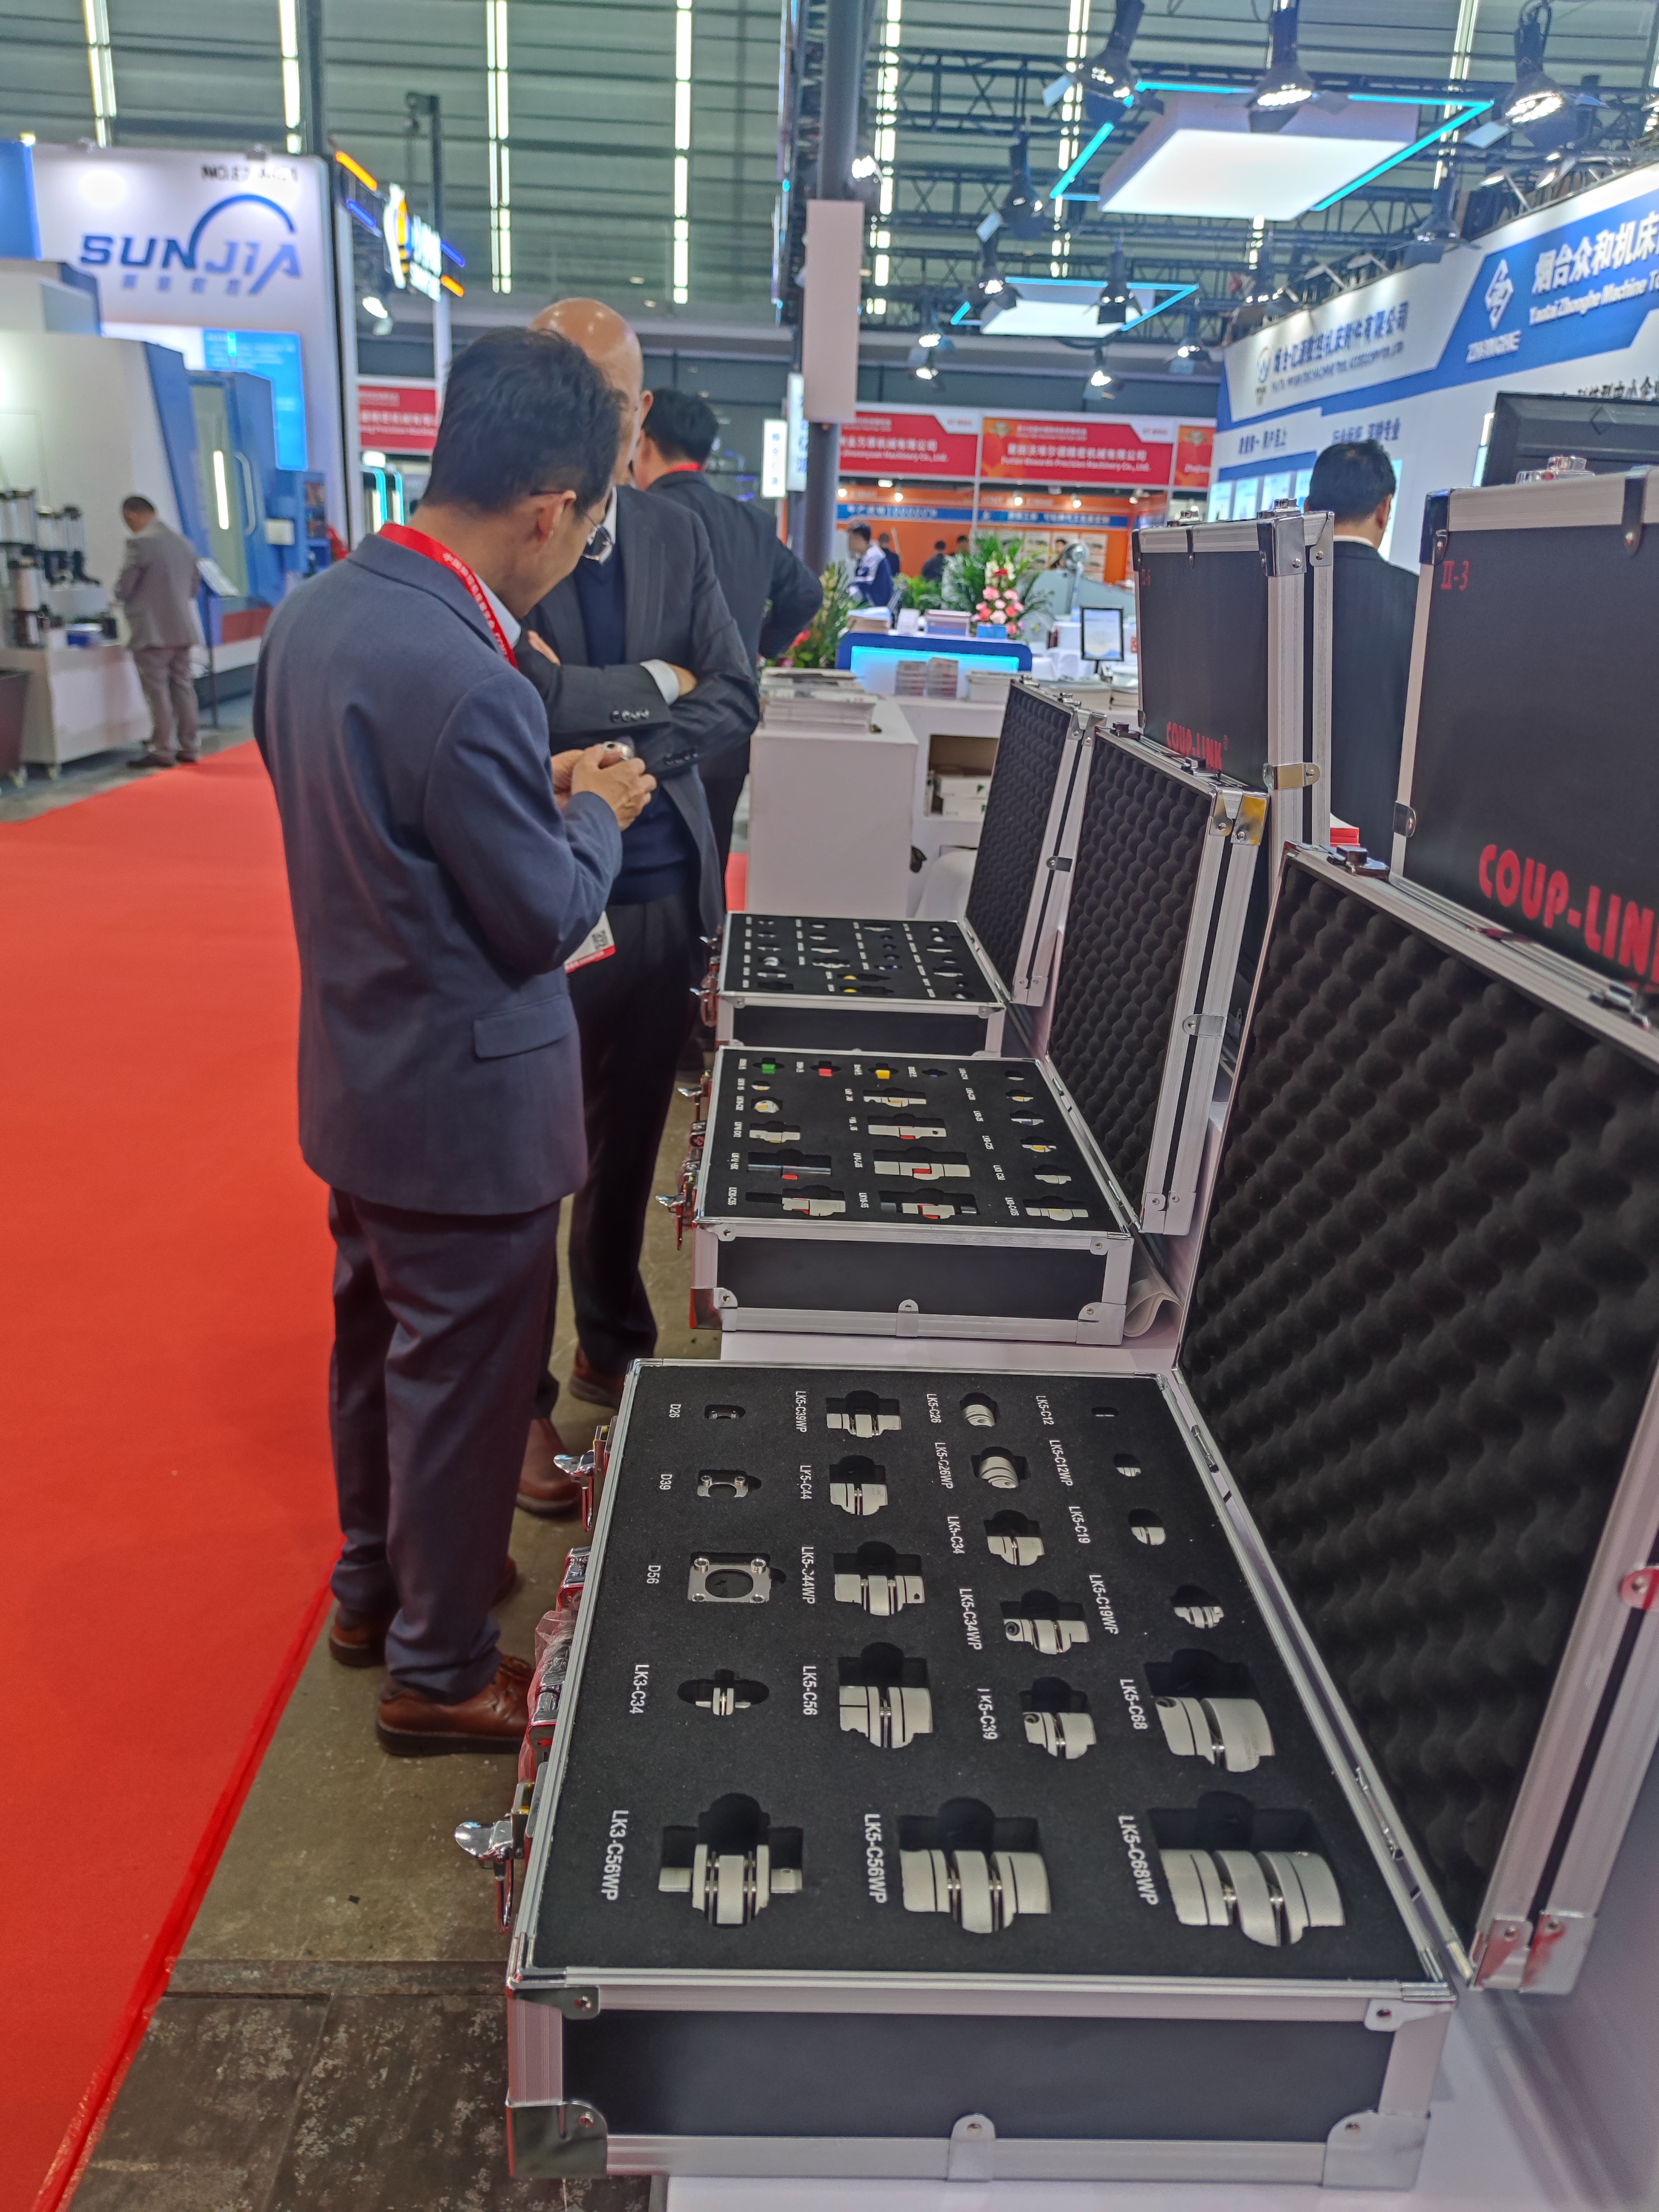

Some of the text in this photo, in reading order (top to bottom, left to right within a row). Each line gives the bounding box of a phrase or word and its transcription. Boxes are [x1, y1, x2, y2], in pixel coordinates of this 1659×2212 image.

[1531, 210, 1659, 295] 烟台众和机床
[1479, 844, 1659, 985] COUP-LIN
[669, 1404, 681, 1418] D26
[795, 1391, 807, 1433] LK5-C39WP
[927, 1394, 941, 1423] LK5-C26
[1036, 1395, 1054, 1425] LK5-C12
[659, 1474, 673, 1490] D39
[935, 1442, 953, 1489] LK5-C26WP
[1049, 1440, 1073, 1486] LK5-C12WP
[1069, 1506, 1090, 1544] LK5-C19
[646, 1565, 661, 1584] D56
[959, 1588, 983, 1650] LK5-C34WP
[629, 1664, 650, 1714] LK3-C34
[803, 1666, 818, 1716] LK5-C56
[1120, 1679, 1148, 1730] LK5-C68
[601, 1810, 629, 1901] LK3-C56WP
[864, 1814, 887, 1903] LK5-C56WP
[1118, 1815, 1159, 1905] LK5-C68WP
